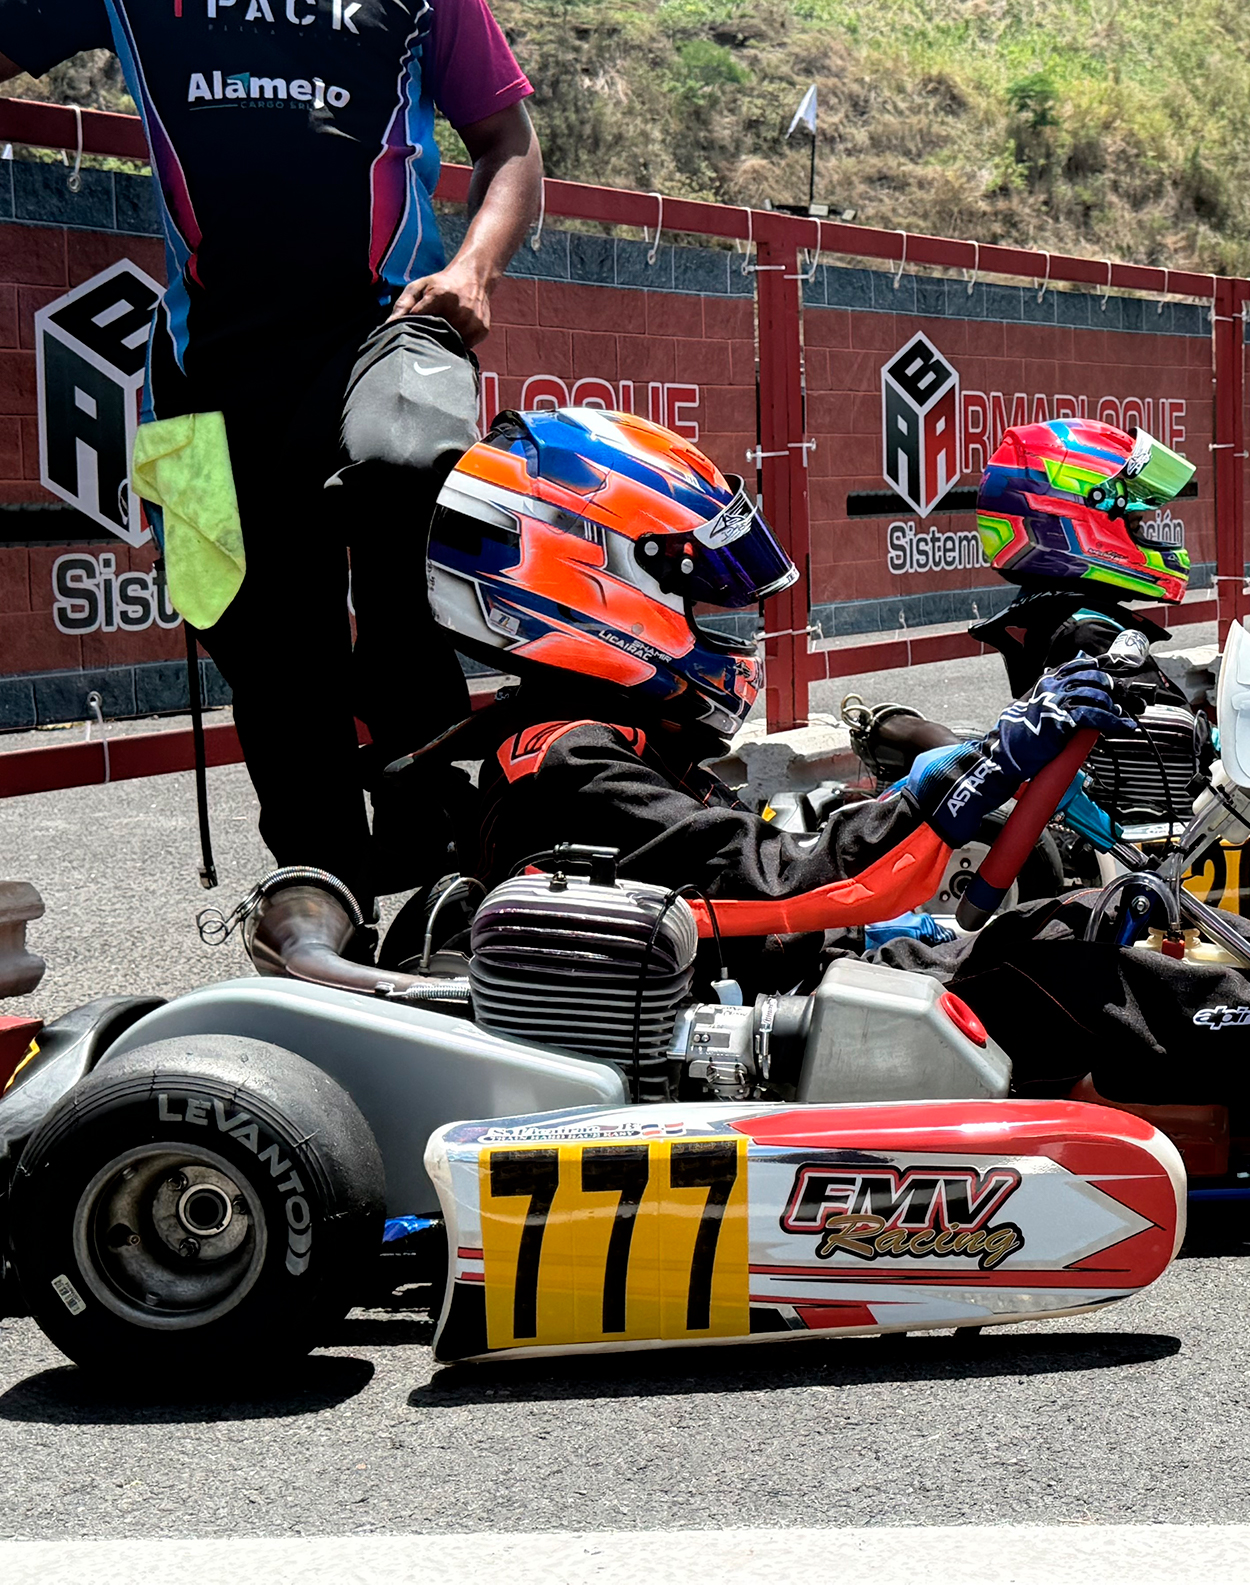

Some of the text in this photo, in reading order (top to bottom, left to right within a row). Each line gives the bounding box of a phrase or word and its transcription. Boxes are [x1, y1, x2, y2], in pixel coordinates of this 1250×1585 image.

[240, 101, 285, 109] CARGO
[598, 629, 653, 661] LICAIRAC
[631, 640, 673, 663] SHAMIR
[158, 1093, 311, 1231] LEVANTO
[785, 1166, 1018, 1231] FMV
[490, 1140, 738, 1339] 777
[821, 1214, 1020, 1268] Racing
